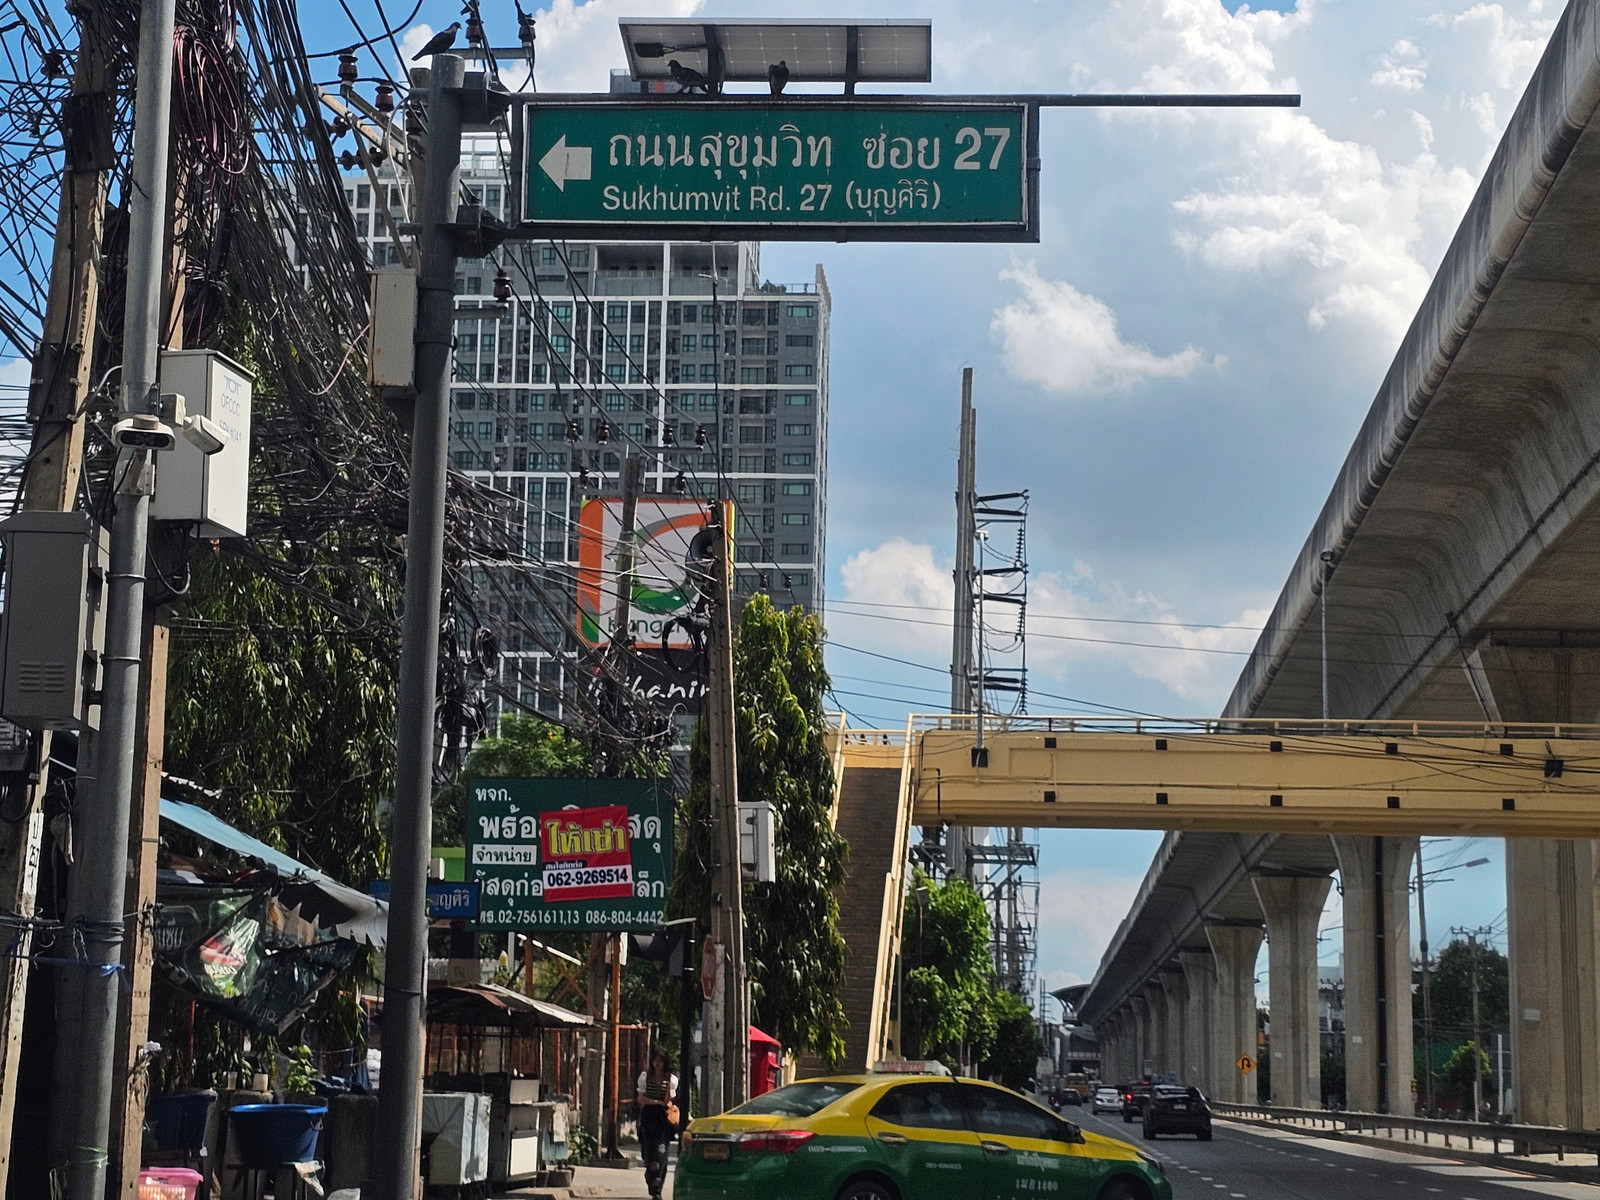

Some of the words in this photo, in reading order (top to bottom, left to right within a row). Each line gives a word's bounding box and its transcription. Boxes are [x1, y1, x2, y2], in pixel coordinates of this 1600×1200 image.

[608, 124, 832, 179] ถนนสุขุมวิท
[864, 132, 940, 169] ซอย
[954, 127, 1011, 171] 27
[602, 185, 741, 212] Sukhumvit
[750, 188, 791, 212] Rd.
[800, 187, 830, 212] 27
[845, 180, 941, 216] (บุญศิริ)
[475, 787, 512, 802] หจก.
[475, 846, 532, 863] จำหน่าย
[547, 868, 629, 887] 062-9269514
[585, 910, 664, 924] 086-804-4442
